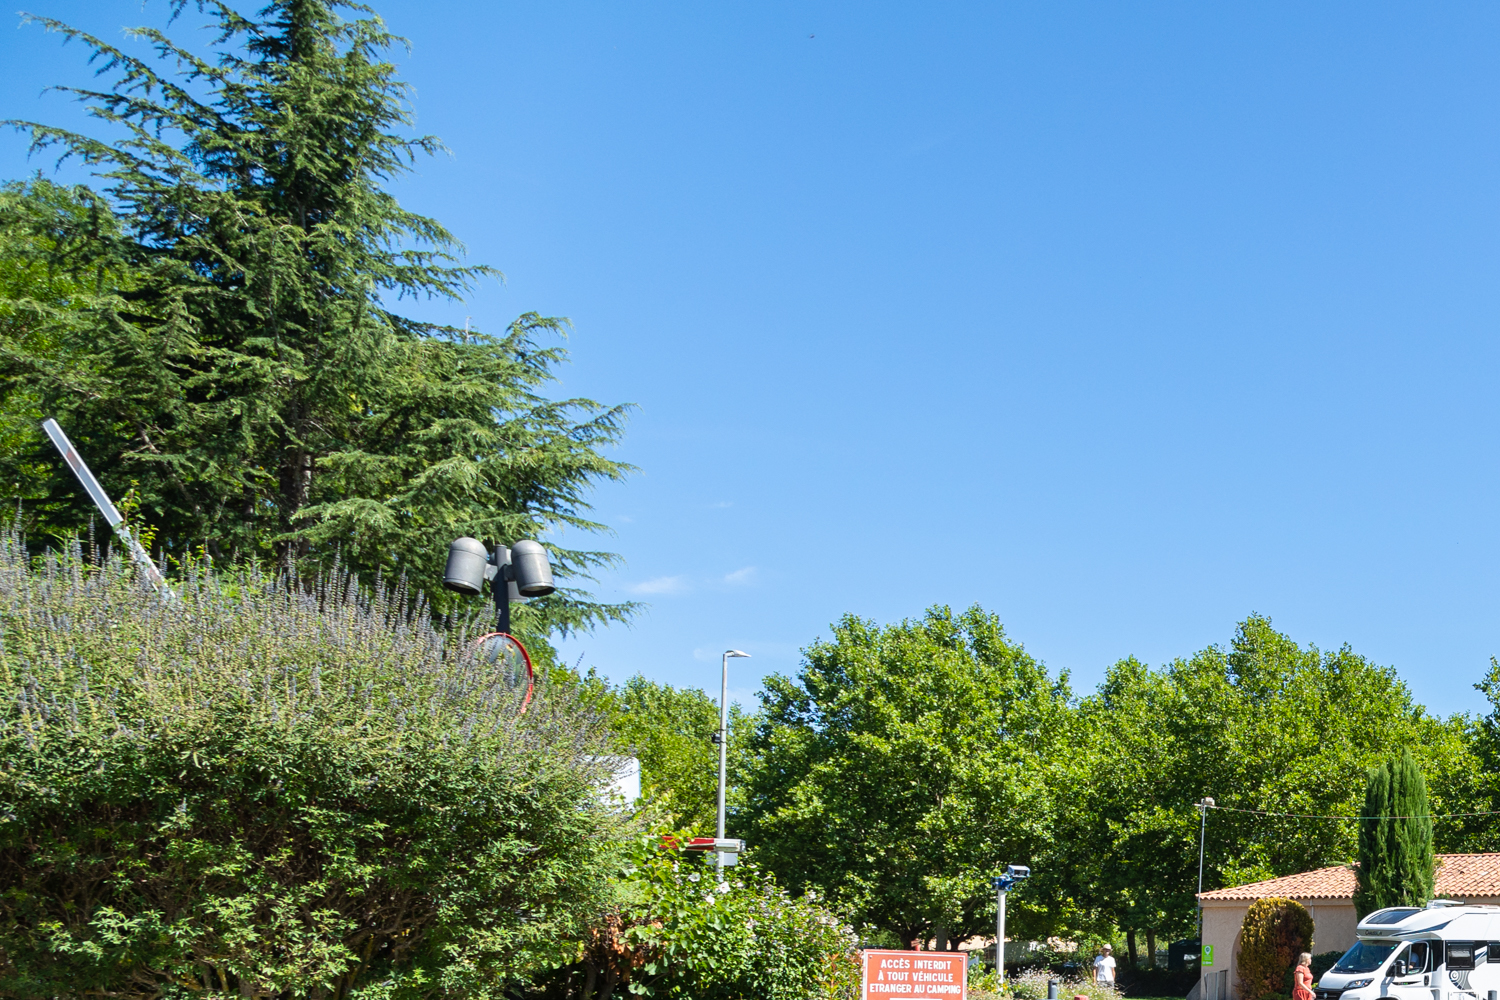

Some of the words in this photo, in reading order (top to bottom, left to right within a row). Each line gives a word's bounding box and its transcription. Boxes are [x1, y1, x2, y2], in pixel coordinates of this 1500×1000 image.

[881, 958, 910, 969] ACCÈS
[914, 960, 951, 970] INTERDIT
[878, 970, 884, 980] À
[887, 971, 909, 981] TOUT
[912, 971, 953, 982] VÉHICULE
[869, 983, 912, 993] ETRANGER
[914, 984, 925, 993] AU
[927, 985, 961, 994] CAMPING
